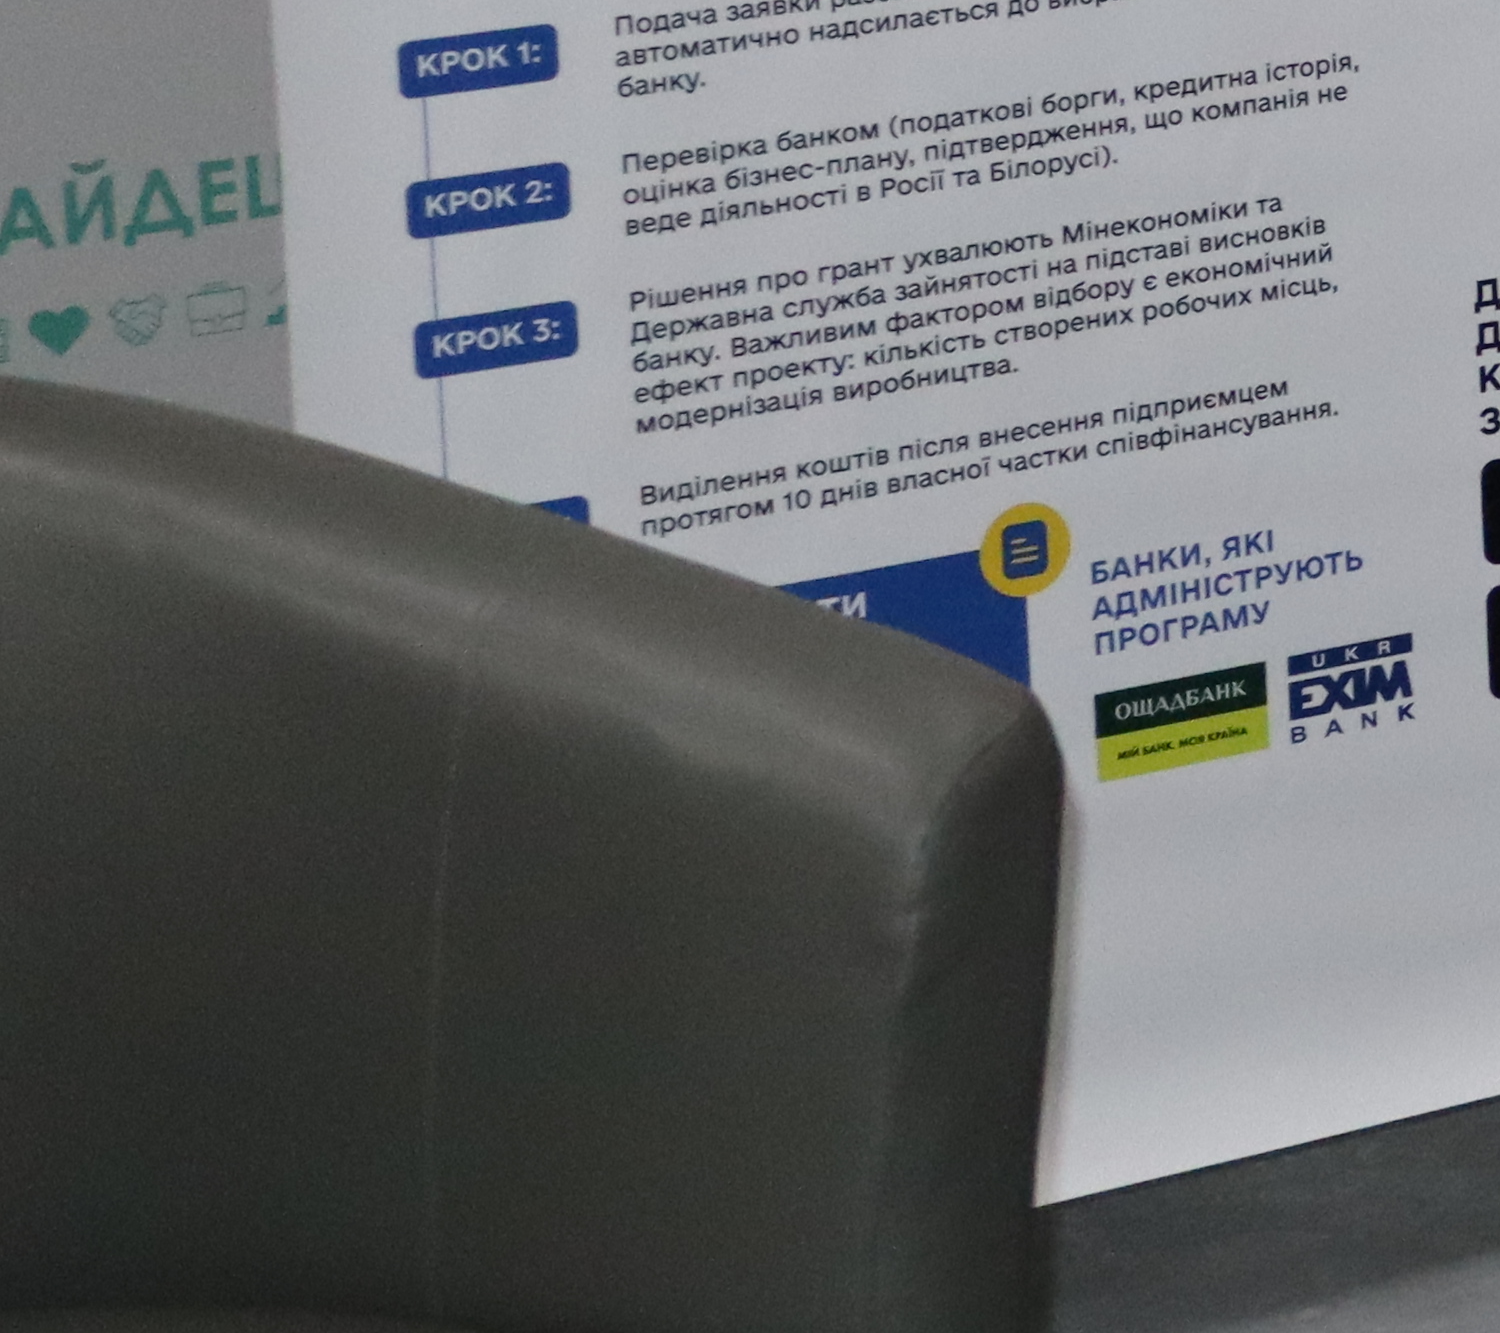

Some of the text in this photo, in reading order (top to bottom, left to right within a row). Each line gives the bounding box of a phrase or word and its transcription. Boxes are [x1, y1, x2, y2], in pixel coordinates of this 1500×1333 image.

[417, 42, 541, 77] КРОК 1:
[425, 180, 552, 217] КРОК 2:
[433, 318, 560, 357] КРОК 3:
[1091, 530, 1273, 584] БАНКИ, ЯКІ
[1092, 551, 1363, 620] АДМІНІСТРУЮТЬ
[1095, 601, 1269, 655] ПРОГРАМУ
[1115, 681, 1246, 720] ОЩАДБАНК
[1289, 660, 1412, 720] EXIM
[1290, 703, 1414, 744] BANK
